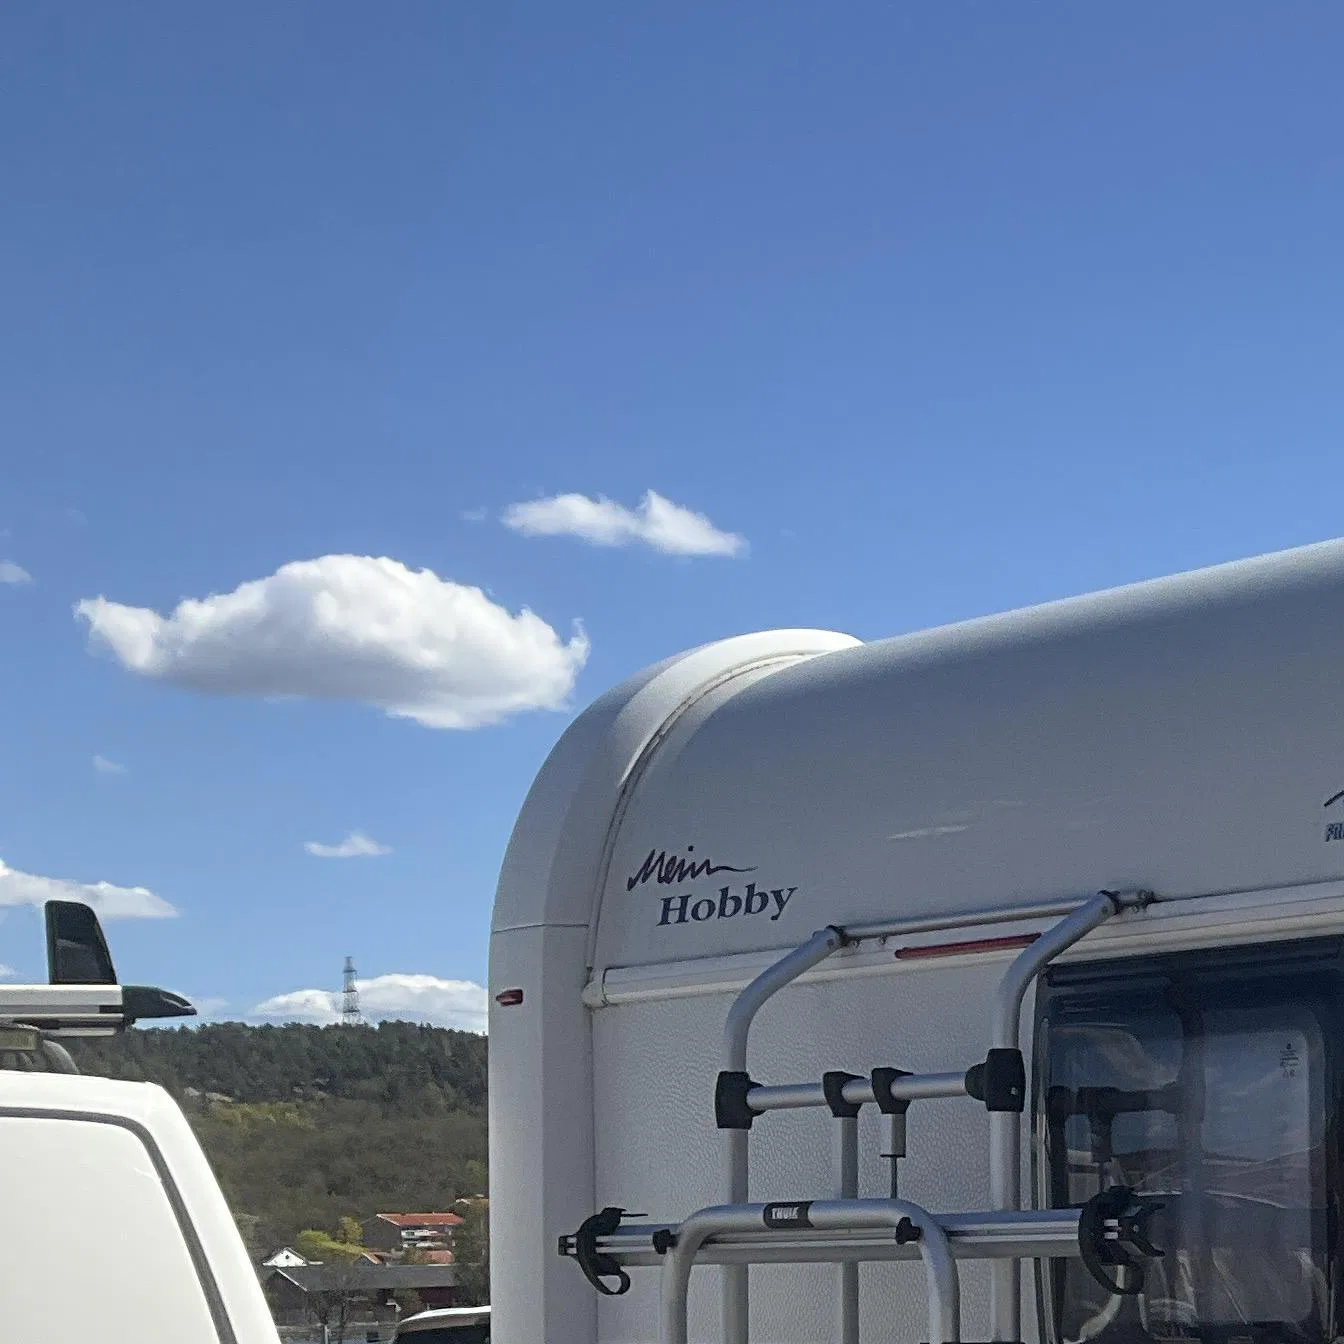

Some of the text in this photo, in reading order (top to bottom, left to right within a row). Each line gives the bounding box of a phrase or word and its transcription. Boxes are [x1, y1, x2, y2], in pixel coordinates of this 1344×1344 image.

[627, 844, 760, 892] Mein
[656, 881, 799, 927] Hobby
[771, 1206, 800, 1220] THULE
